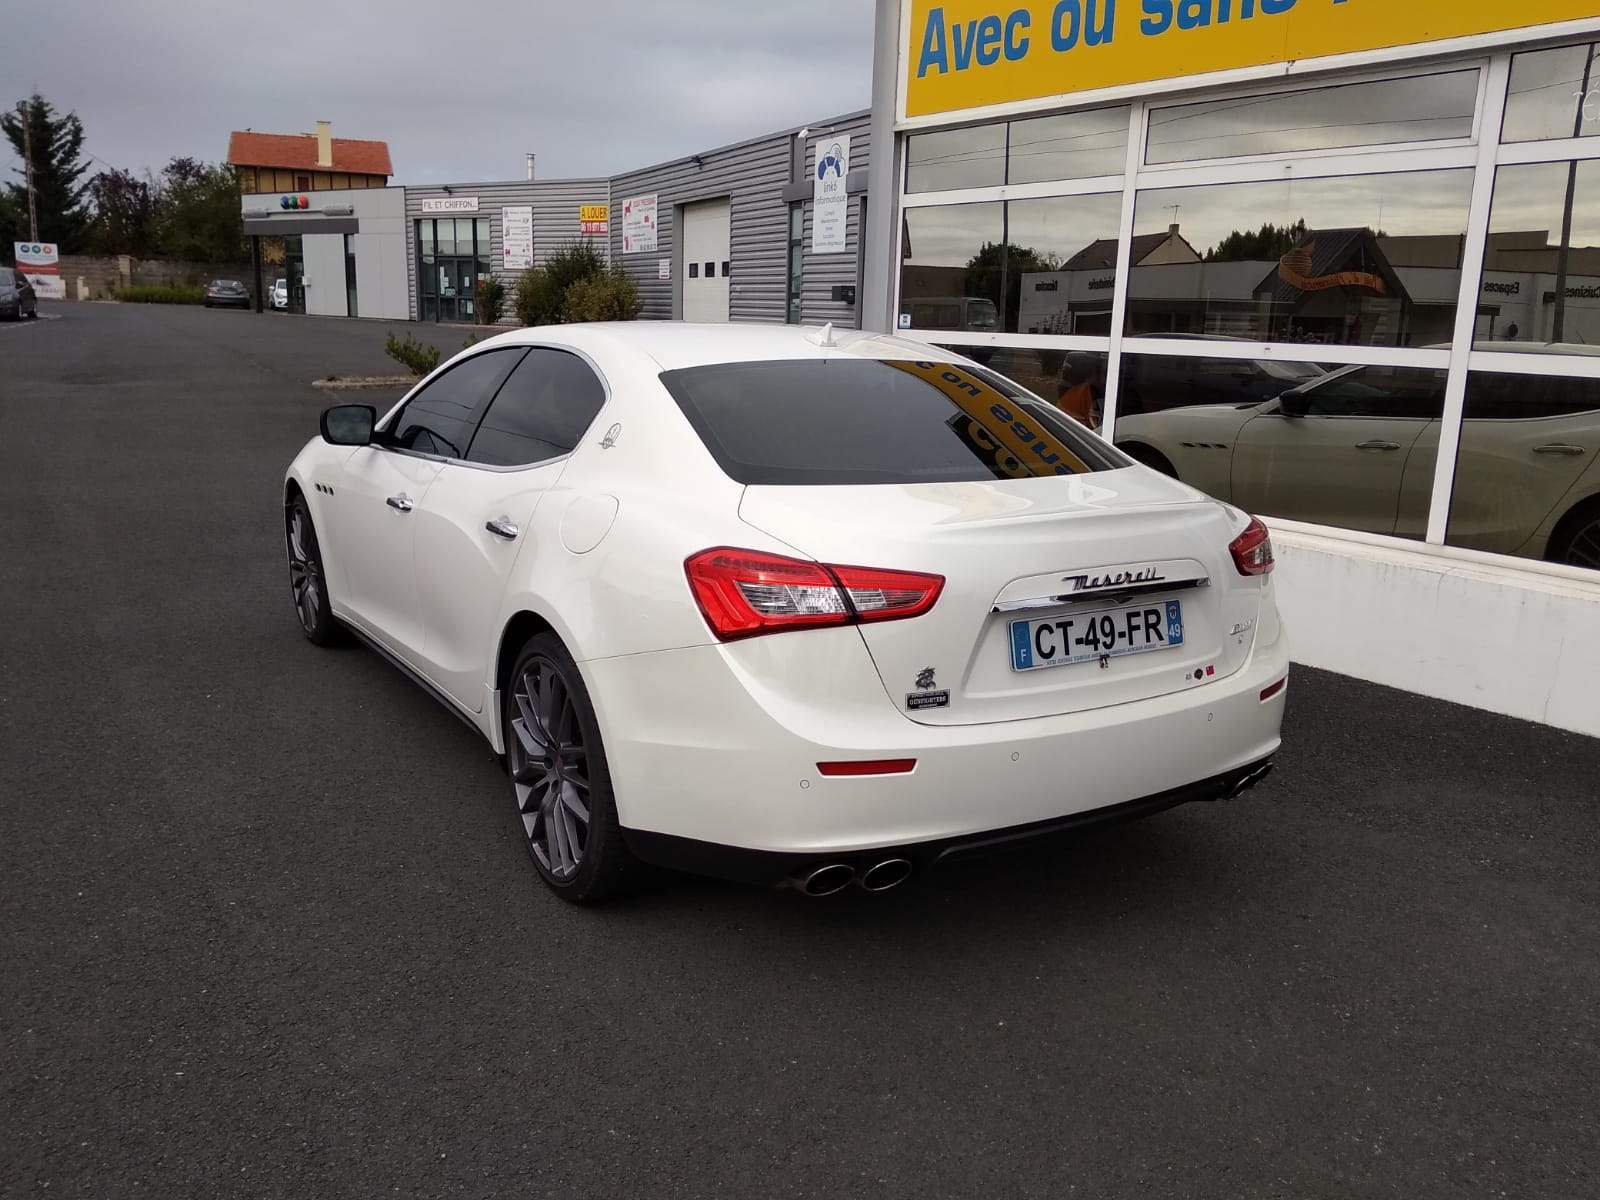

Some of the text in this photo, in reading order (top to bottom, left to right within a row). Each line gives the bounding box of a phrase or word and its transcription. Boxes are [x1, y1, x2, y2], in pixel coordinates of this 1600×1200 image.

[917, 7, 1031, 78] Avec
[1051, 0, 1116, 52] ou
[424, 201, 433, 209] FIL
[435, 201, 443, 209] ET
[587, 207, 607, 219] LOUER
[1062, 567, 1166, 591] Maserati
[1020, 648, 1027, 662] F
[1035, 608, 1165, 660] CT-49-FR
[1168, 624, 1181, 638] 49
